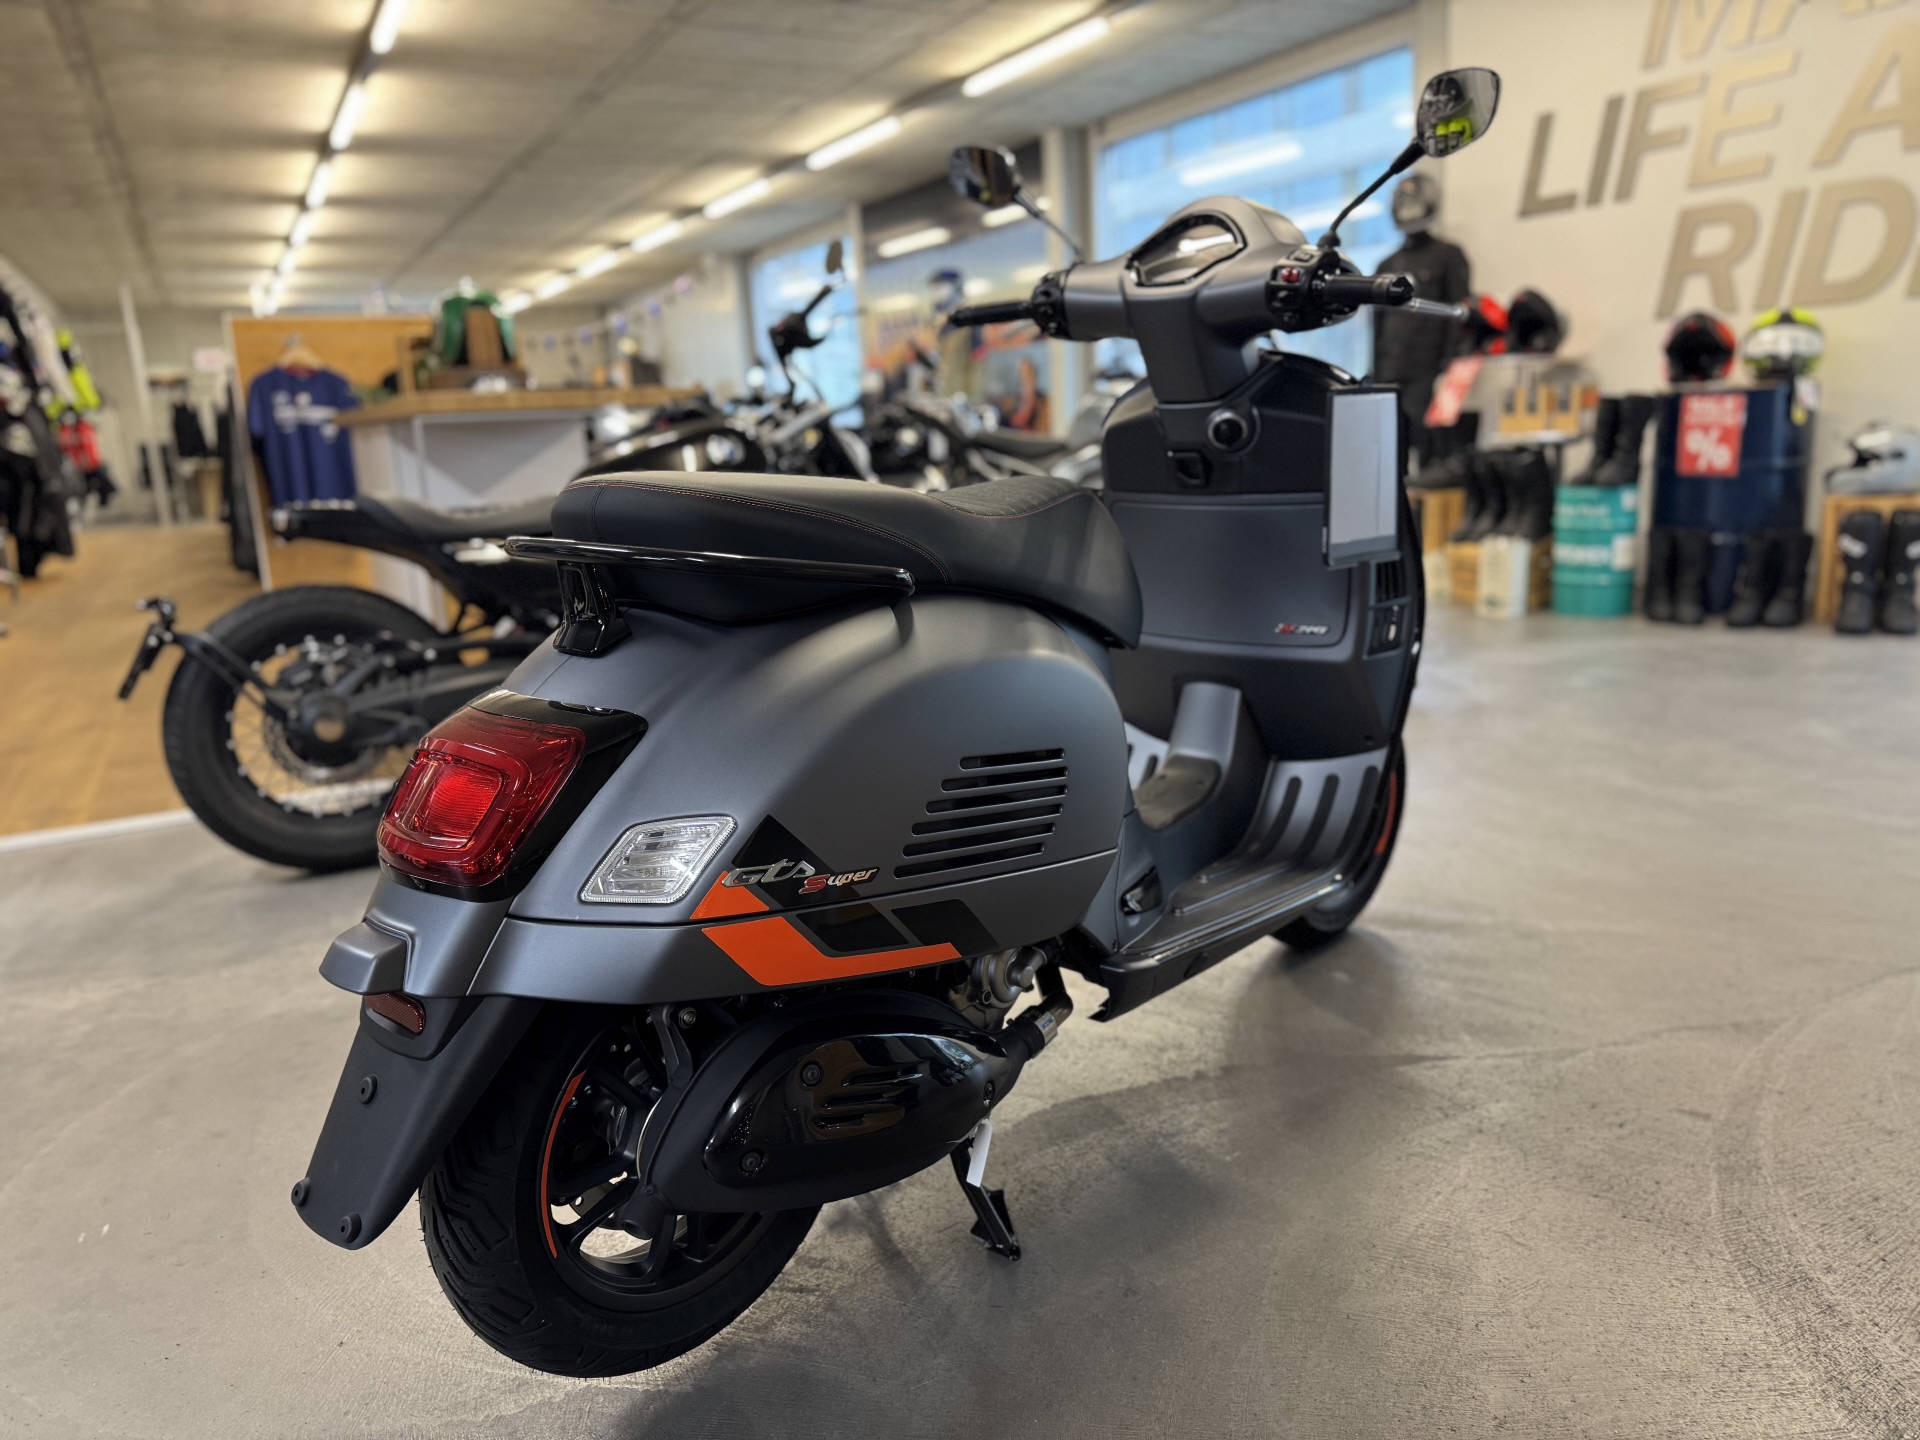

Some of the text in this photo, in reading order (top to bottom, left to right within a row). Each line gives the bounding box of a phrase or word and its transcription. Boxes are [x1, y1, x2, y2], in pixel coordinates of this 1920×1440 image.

[1517, 48, 1798, 218] LIFE
[1811, 18, 1920, 168] A
[1655, 177, 1920, 320] RID
[798, 867, 879, 895] Super
